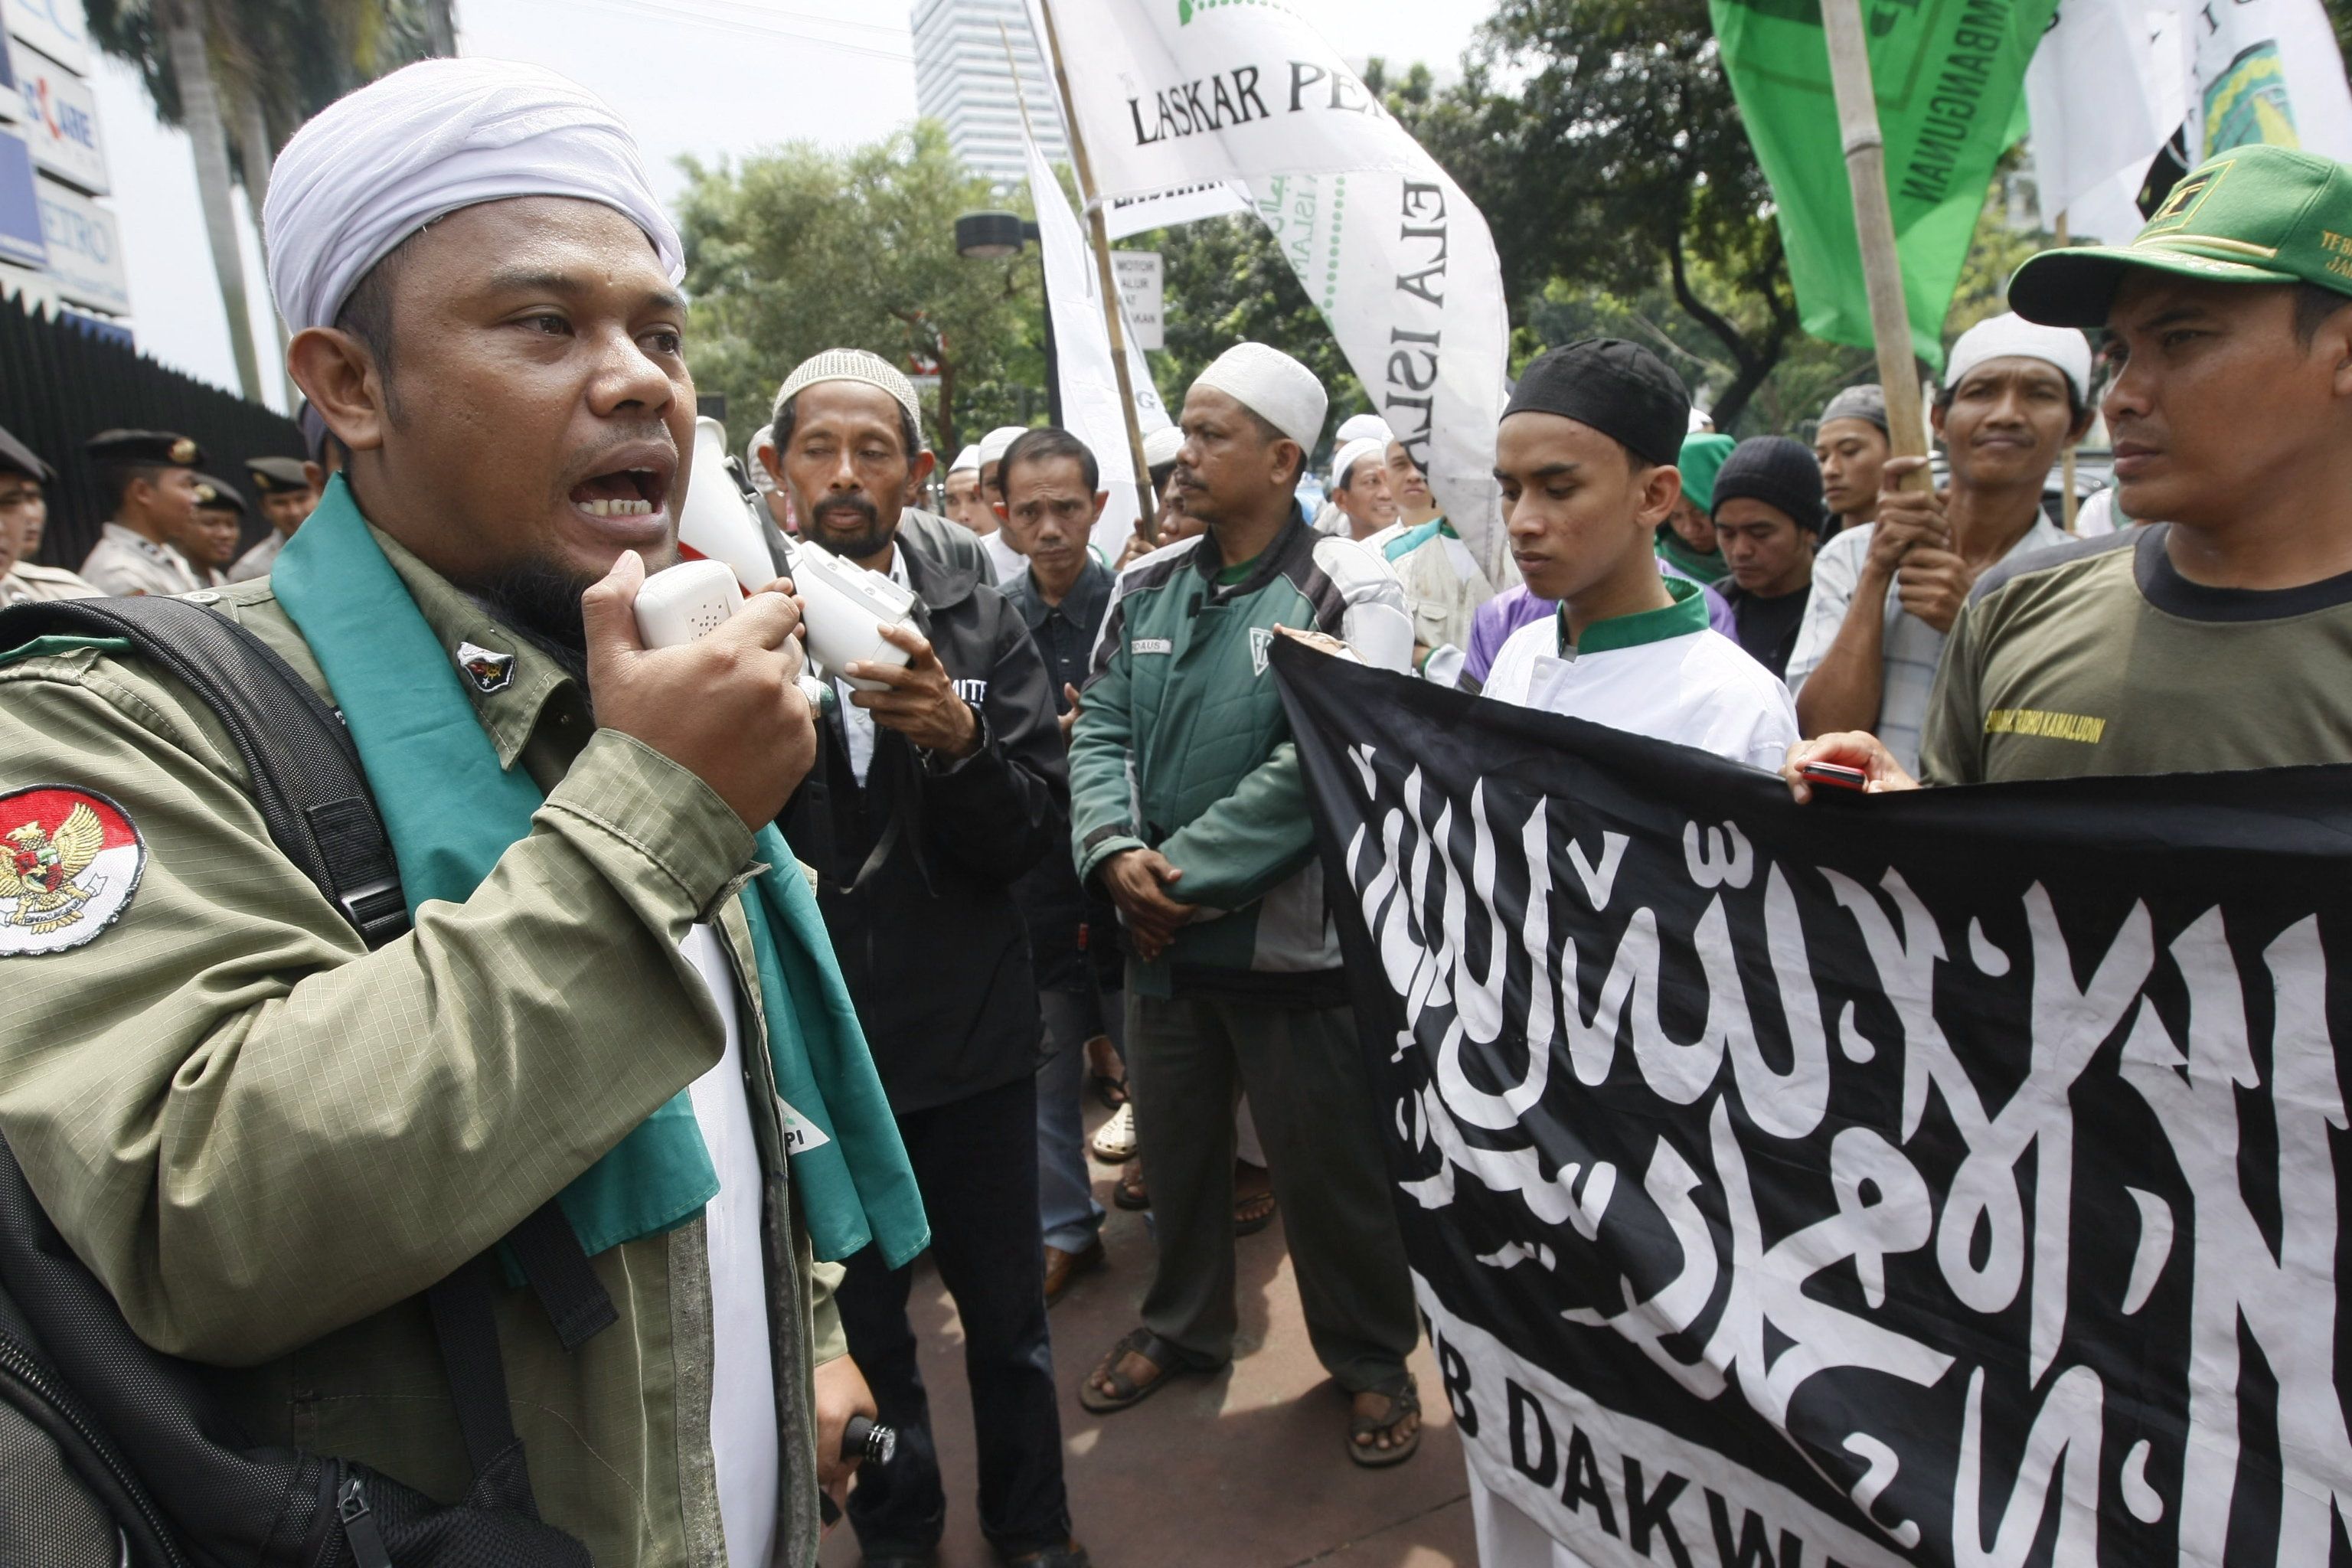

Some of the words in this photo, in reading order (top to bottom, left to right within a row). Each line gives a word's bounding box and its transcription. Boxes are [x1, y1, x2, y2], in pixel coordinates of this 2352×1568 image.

[1128, 65, 1270, 145] LASKAR
[1287, 60, 1384, 119] PE
[1505, 1377, 1847, 1568] DAKW
